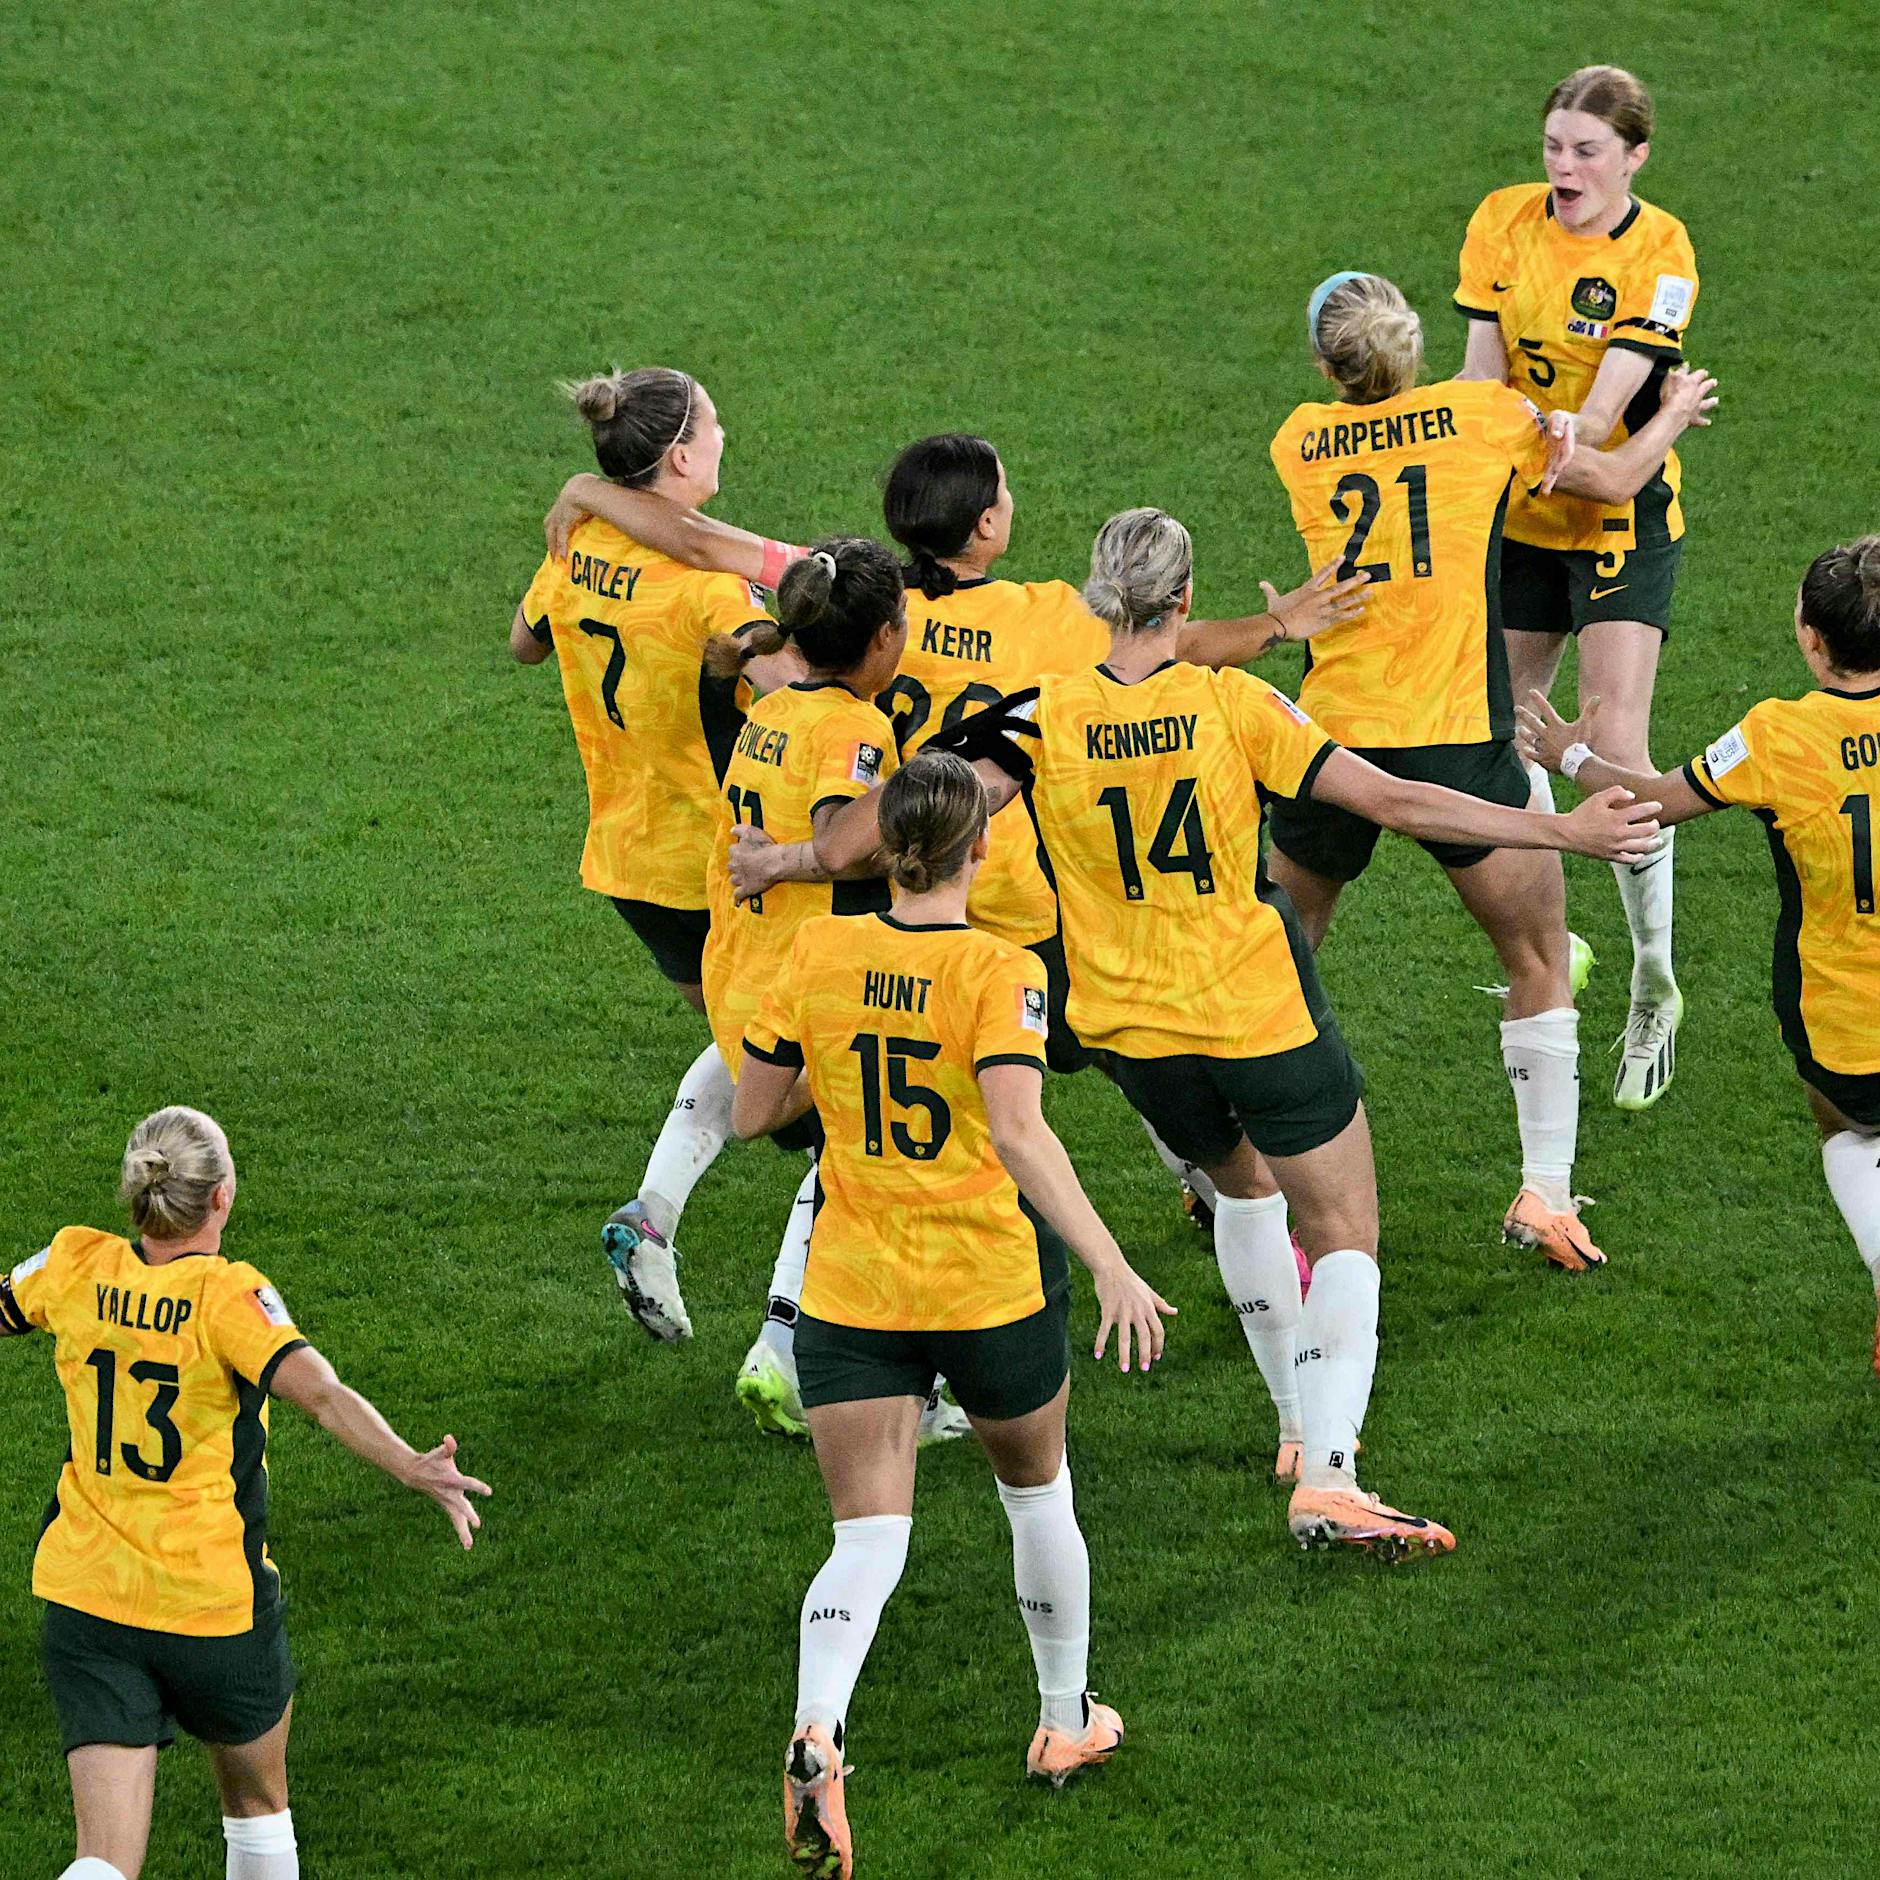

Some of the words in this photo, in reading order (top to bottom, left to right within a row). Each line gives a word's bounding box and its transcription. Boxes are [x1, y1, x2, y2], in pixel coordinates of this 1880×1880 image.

[1518, 338, 1555, 388] 5
[1300, 406, 1458, 463] CARPENTER
[1329, 464, 1433, 584] 21
[571, 550, 641, 602] CATLEY
[921, 618, 993, 664] KERR
[578, 617, 626, 732] 7
[1086, 714, 1198, 760] KENNEDY
[1840, 731, 1880, 771] GO
[1096, 777, 1214, 901] 14
[863, 969, 933, 1014] HUNT
[848, 1032, 952, 1161] 15
[96, 1283, 192, 1336] YALLOP
[84, 1347, 183, 1483] 13
[809, 1608, 851, 1623] AUS
